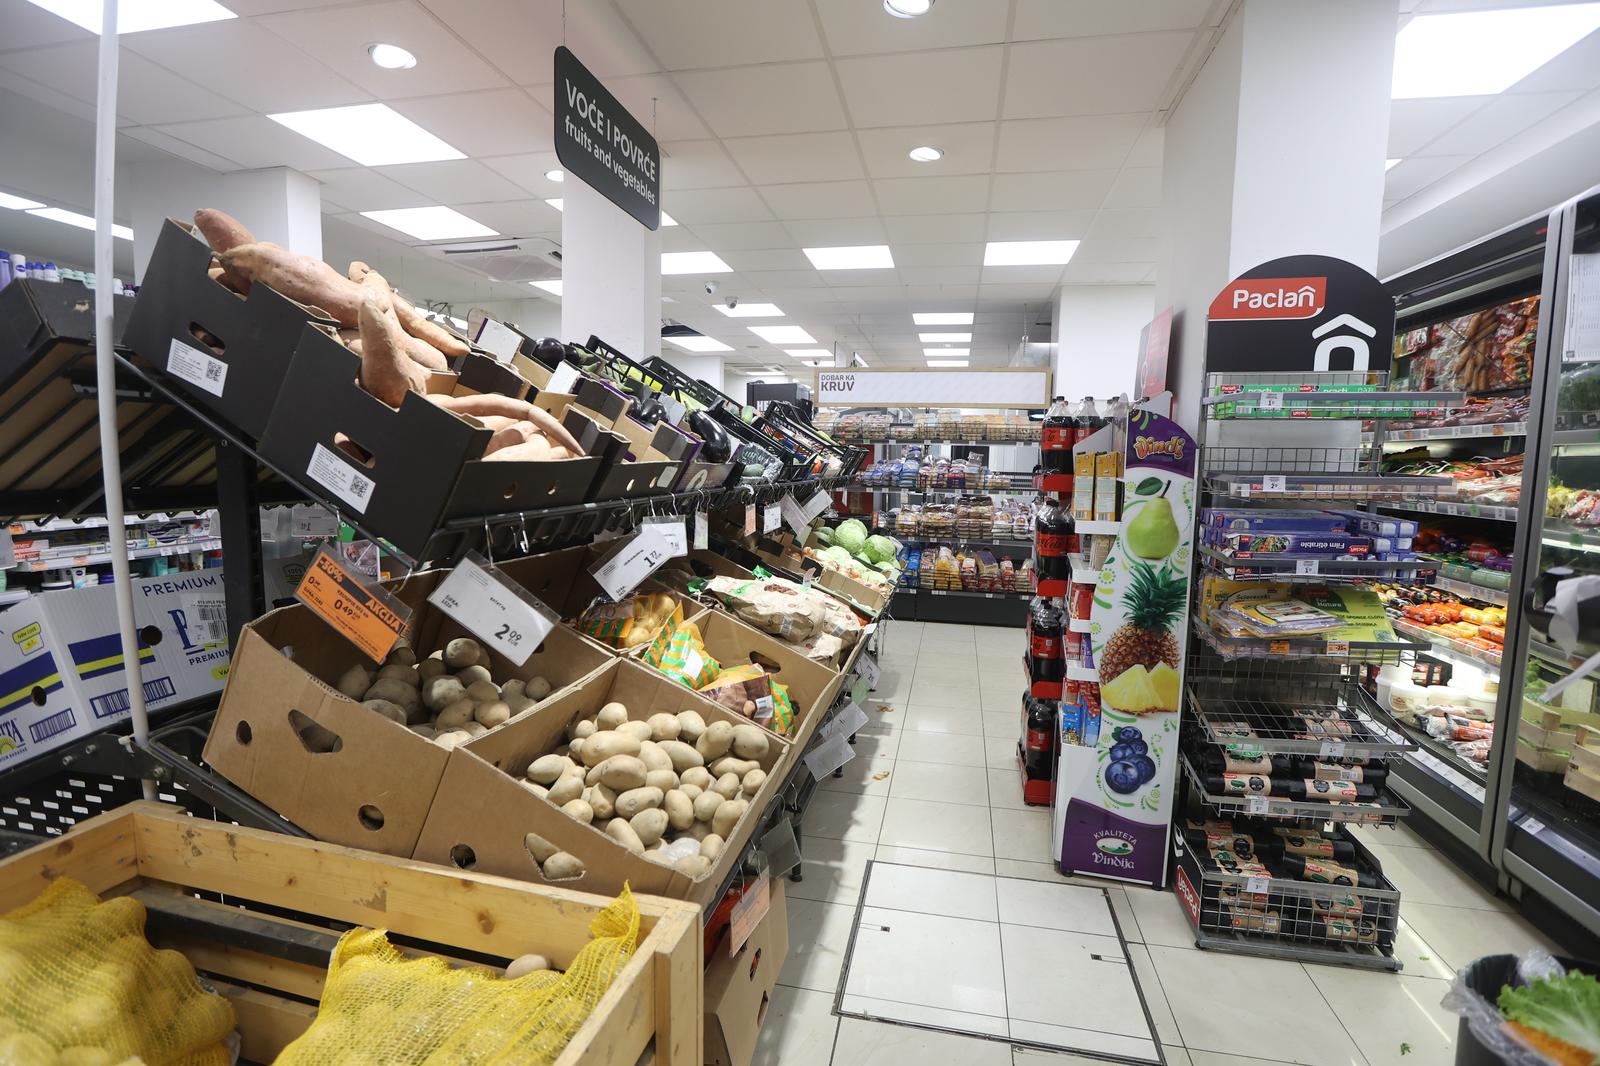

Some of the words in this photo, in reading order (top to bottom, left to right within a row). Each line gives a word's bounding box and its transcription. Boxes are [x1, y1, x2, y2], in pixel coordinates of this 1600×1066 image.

[566, 78, 604, 136] VOĆE
[606, 119, 611, 142] I
[613, 125, 656, 182] POVRĆE
[565, 115, 592, 153] fruits
[593, 144, 612, 169] and
[613, 159, 656, 206] vegetables
[820, 381, 855, 392] KRUV
[643, 557, 656, 568] 1
[141, 576, 217, 598] PREMIUM
[318, 557, 345, 583] -50%
[364, 599, 401, 632] AKCIJA
[334, 599, 343, 610] 0
[342, 605, 353, 617] 49
[494, 623, 510, 641] 2
[509, 630, 522, 641] 09
[1093, 829, 1137, 845] KVALITETA
[1091, 851, 1135, 869] Vindija
